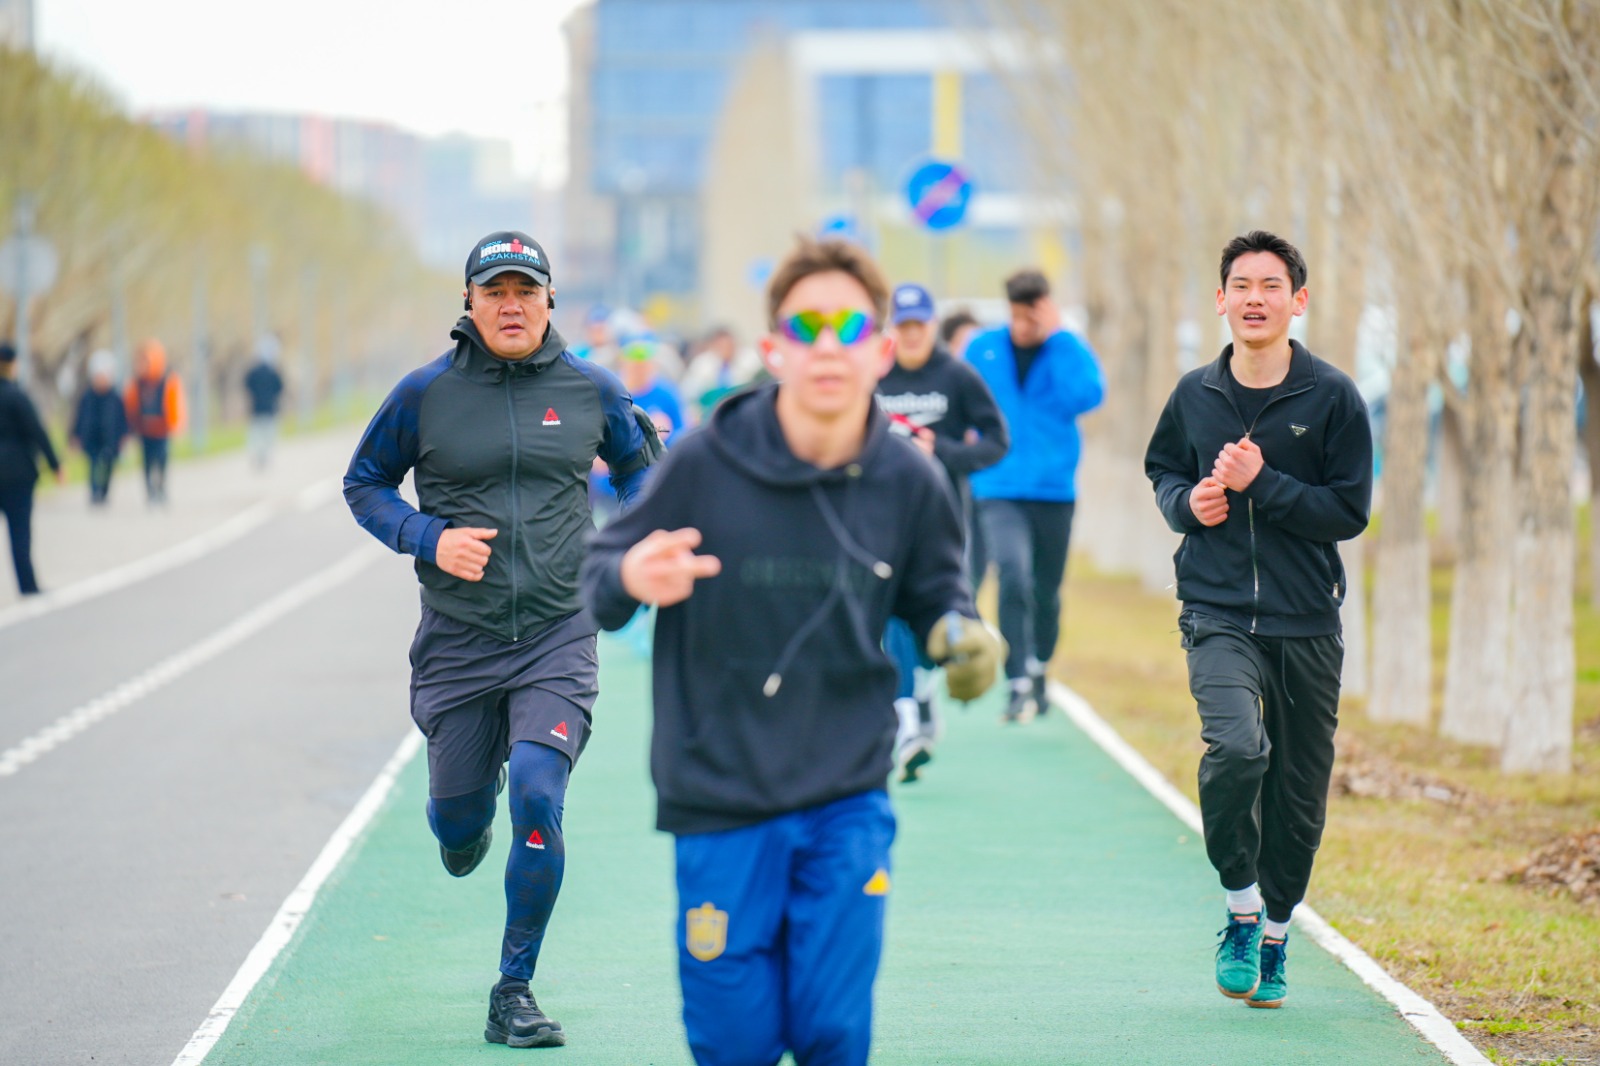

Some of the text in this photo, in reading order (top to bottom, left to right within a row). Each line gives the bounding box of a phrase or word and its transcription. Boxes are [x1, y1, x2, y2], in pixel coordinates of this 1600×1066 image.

[480, 239, 539, 259] IRONMAN
[480, 253, 541, 266] KAZAKHSTAN
[550, 729, 568, 742] Reebok
[525, 840, 545, 850] Reebok
